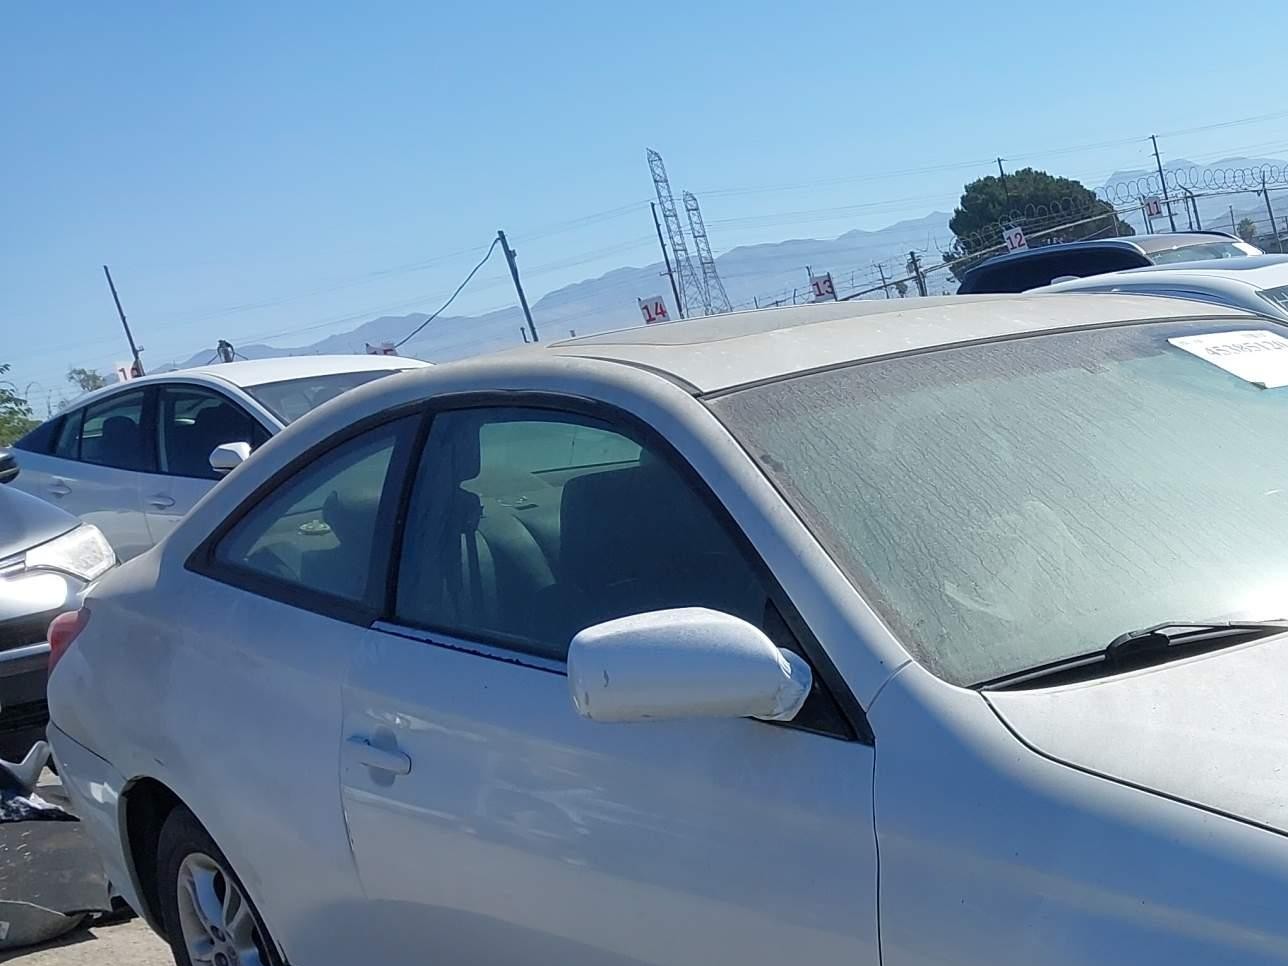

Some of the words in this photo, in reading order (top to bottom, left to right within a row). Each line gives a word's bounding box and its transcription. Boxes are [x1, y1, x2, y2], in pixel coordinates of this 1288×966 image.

[1146, 201, 1162, 216] 11
[1006, 232, 1026, 251] 12
[812, 279, 834, 297] 13
[641, 301, 668, 322] 14
